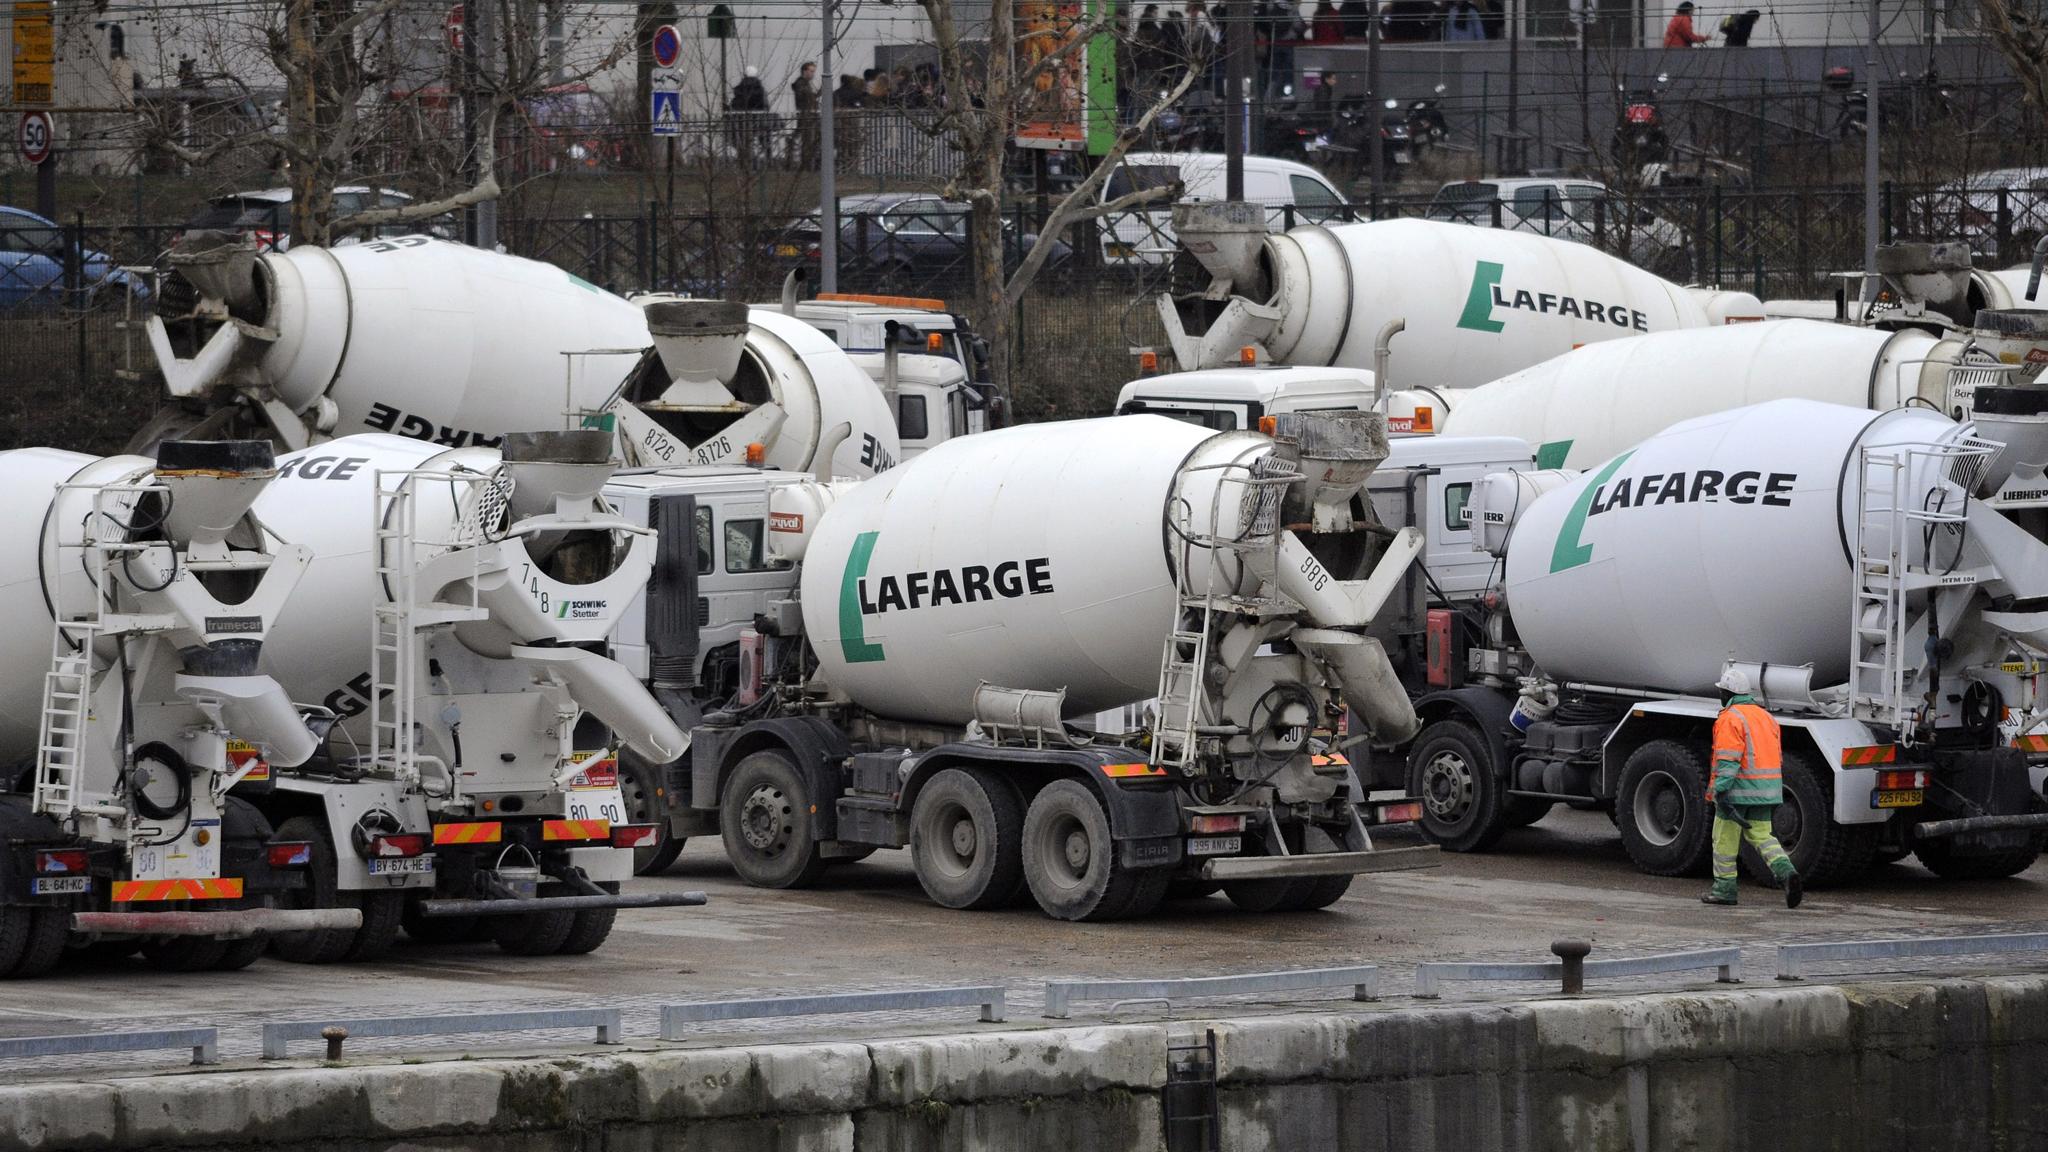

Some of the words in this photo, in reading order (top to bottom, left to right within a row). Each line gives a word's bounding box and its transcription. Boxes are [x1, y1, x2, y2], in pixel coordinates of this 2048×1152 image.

[26, 123, 45, 147] 50
[1492, 286, 1648, 332] LAFARGE
[645, 428, 676, 461] 8726
[697, 436, 732, 465] 8726
[1588, 470, 1798, 517] LAFARGE
[858, 557, 1054, 615] LAFARGE
[1301, 556, 1328, 591] 986
[572, 601, 607, 609] SCHWING
[572, 610, 600, 618] Stetter
[570, 804, 589, 820] 80
[600, 803, 619, 823] 90
